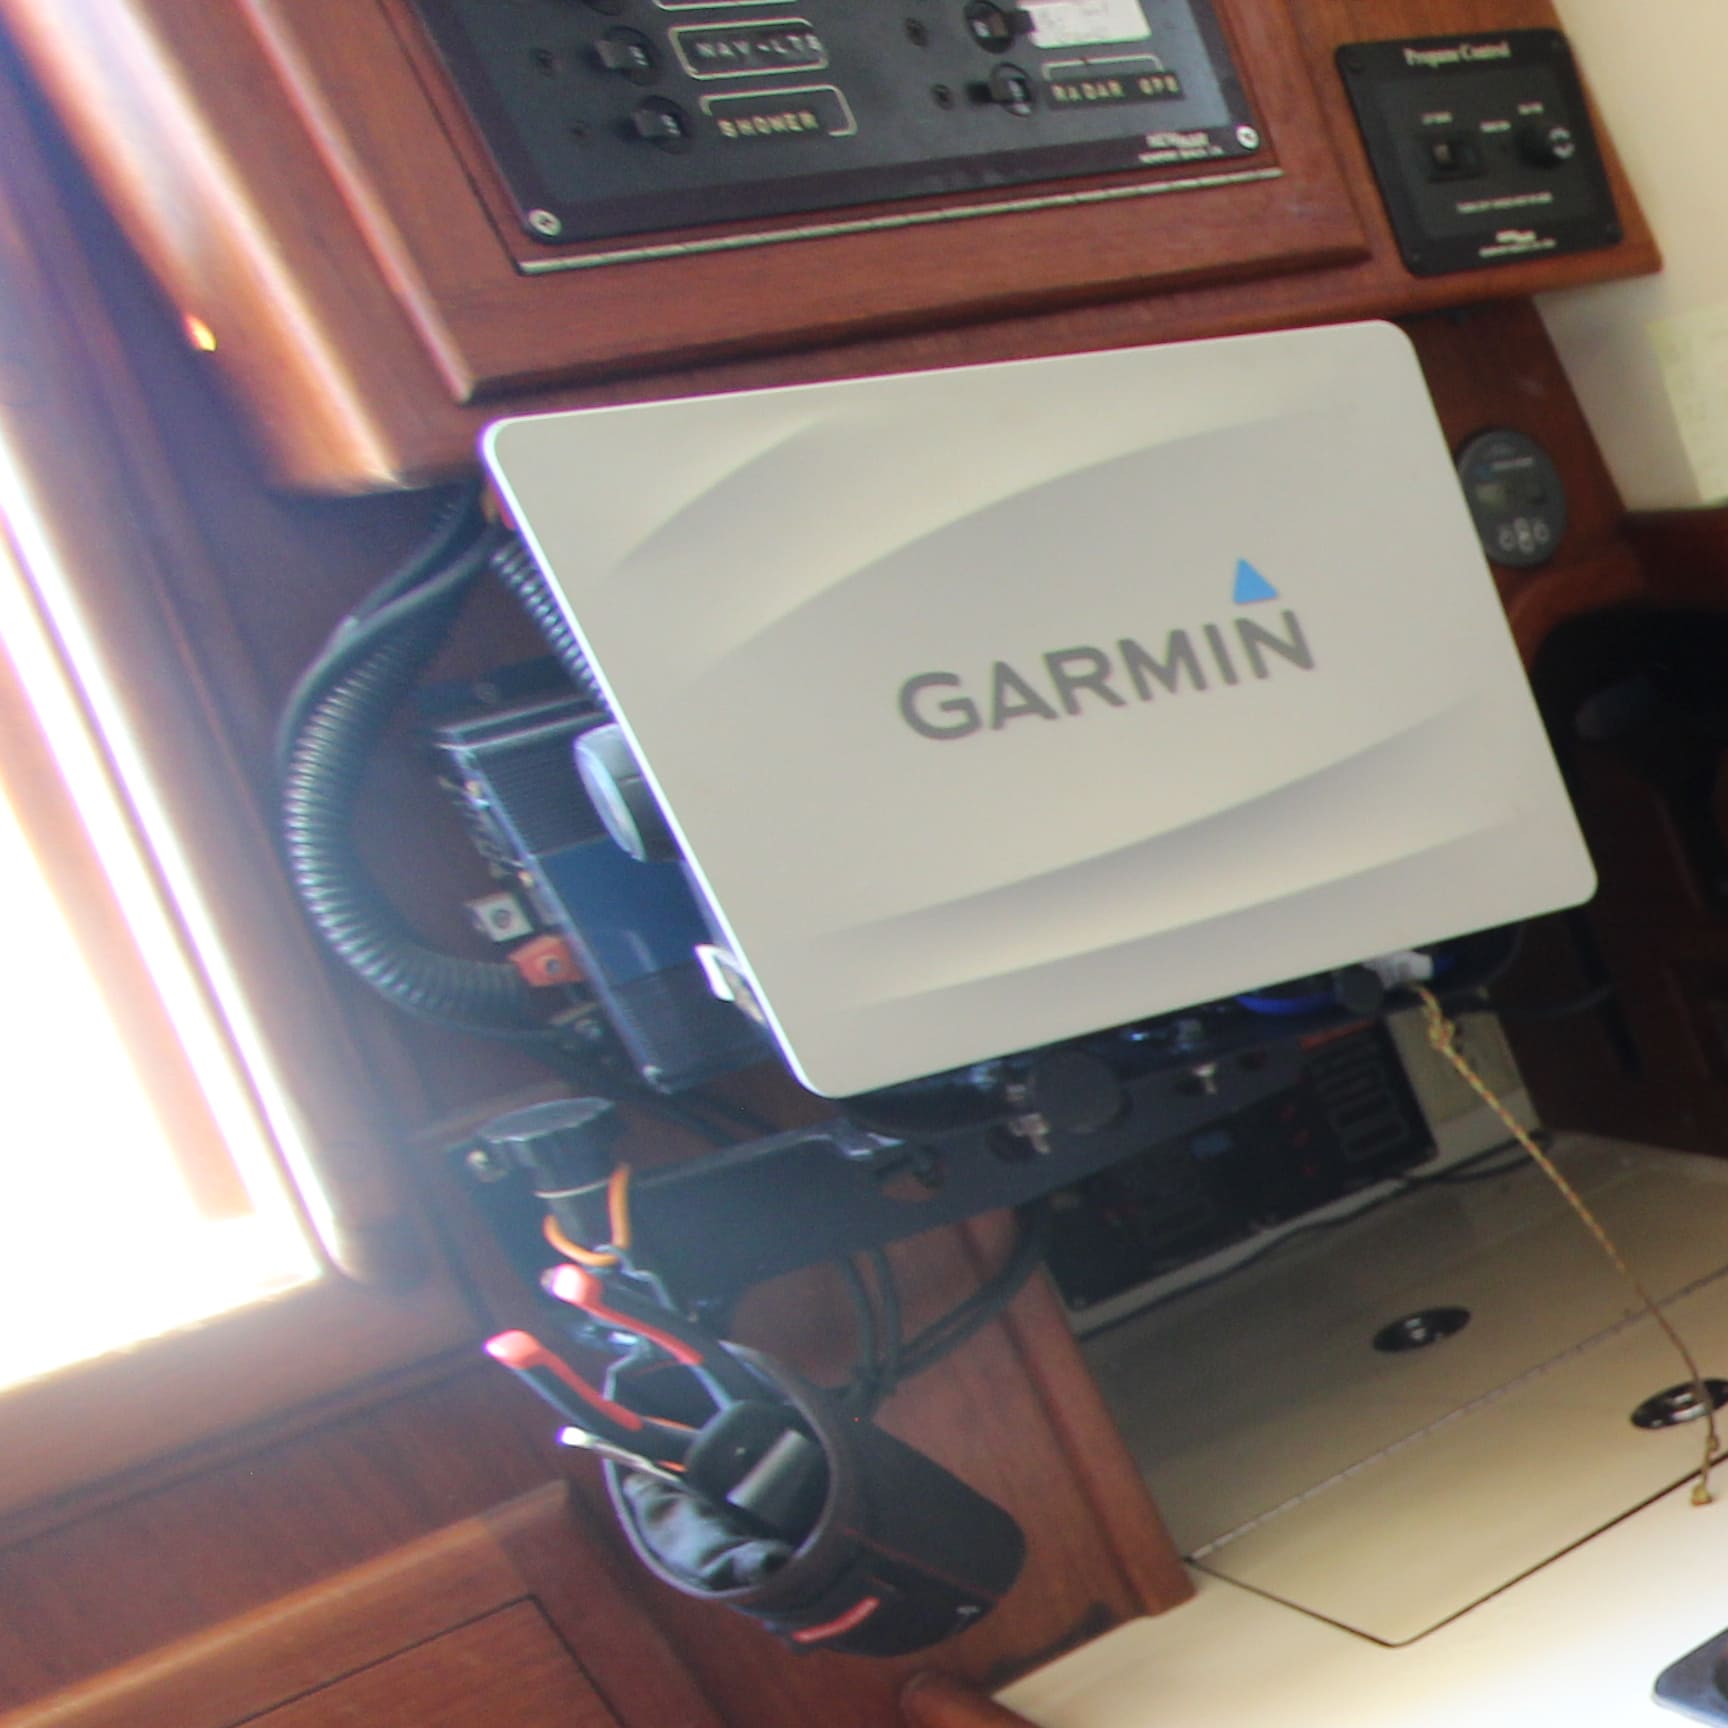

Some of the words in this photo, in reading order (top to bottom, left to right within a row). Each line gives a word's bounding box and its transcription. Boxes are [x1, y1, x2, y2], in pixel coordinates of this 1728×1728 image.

[1052, 79, 1124, 101] RADAR
[718, 110, 820, 138] SHOWER
[897, 609, 1315, 741] GARMIN
